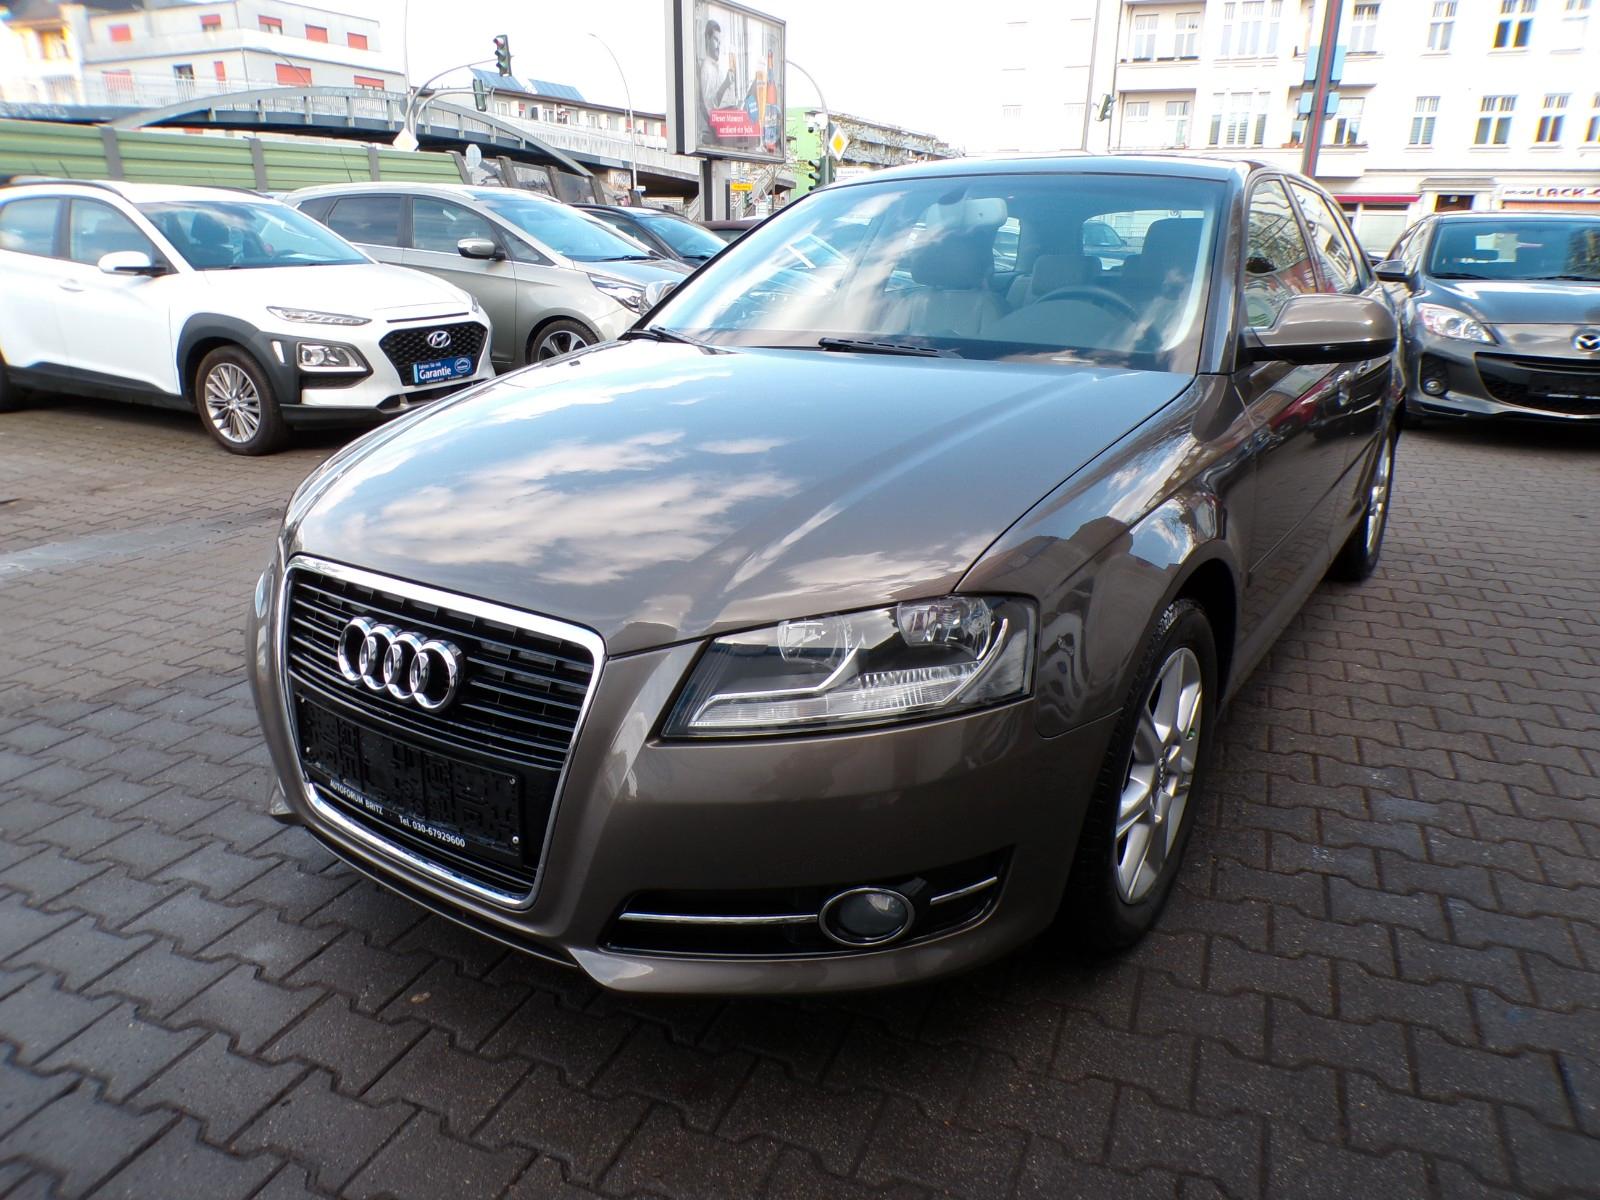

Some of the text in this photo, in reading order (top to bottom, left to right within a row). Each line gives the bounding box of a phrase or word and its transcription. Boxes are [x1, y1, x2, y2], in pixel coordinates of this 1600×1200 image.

[419, 365, 452, 380] Garantie
[330, 779, 466, 848] AUTOFORUM BRITZ Tel. 030-67929600
